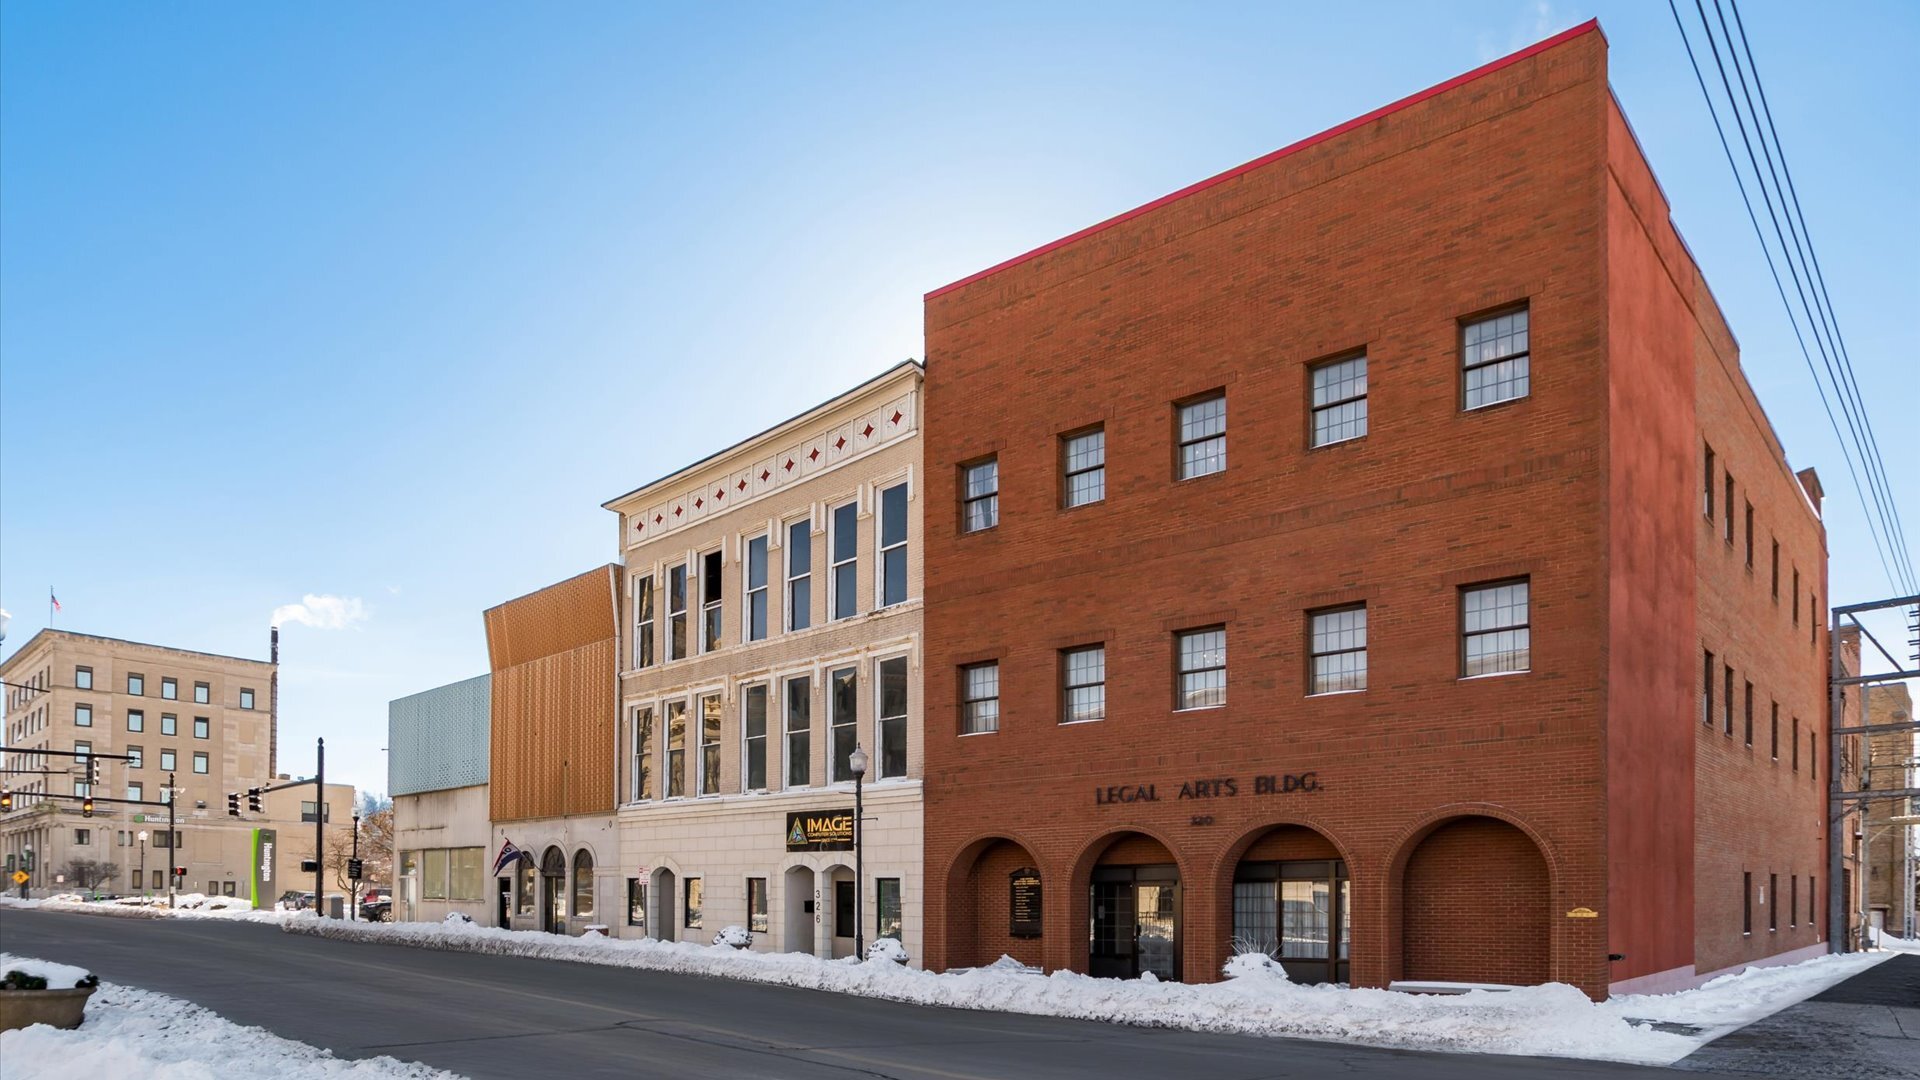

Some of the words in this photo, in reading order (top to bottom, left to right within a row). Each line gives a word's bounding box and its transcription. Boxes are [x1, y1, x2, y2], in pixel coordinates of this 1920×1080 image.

[1096, 784, 1160, 805] LEGAL
[1178, 778, 1238, 799] ARTS
[1254, 772, 1324, 795] BLDG.
[144, 815, 185, 824] Huntinon
[807, 816, 852, 832] IMAGE
[260, 842, 273, 882] Huntington
